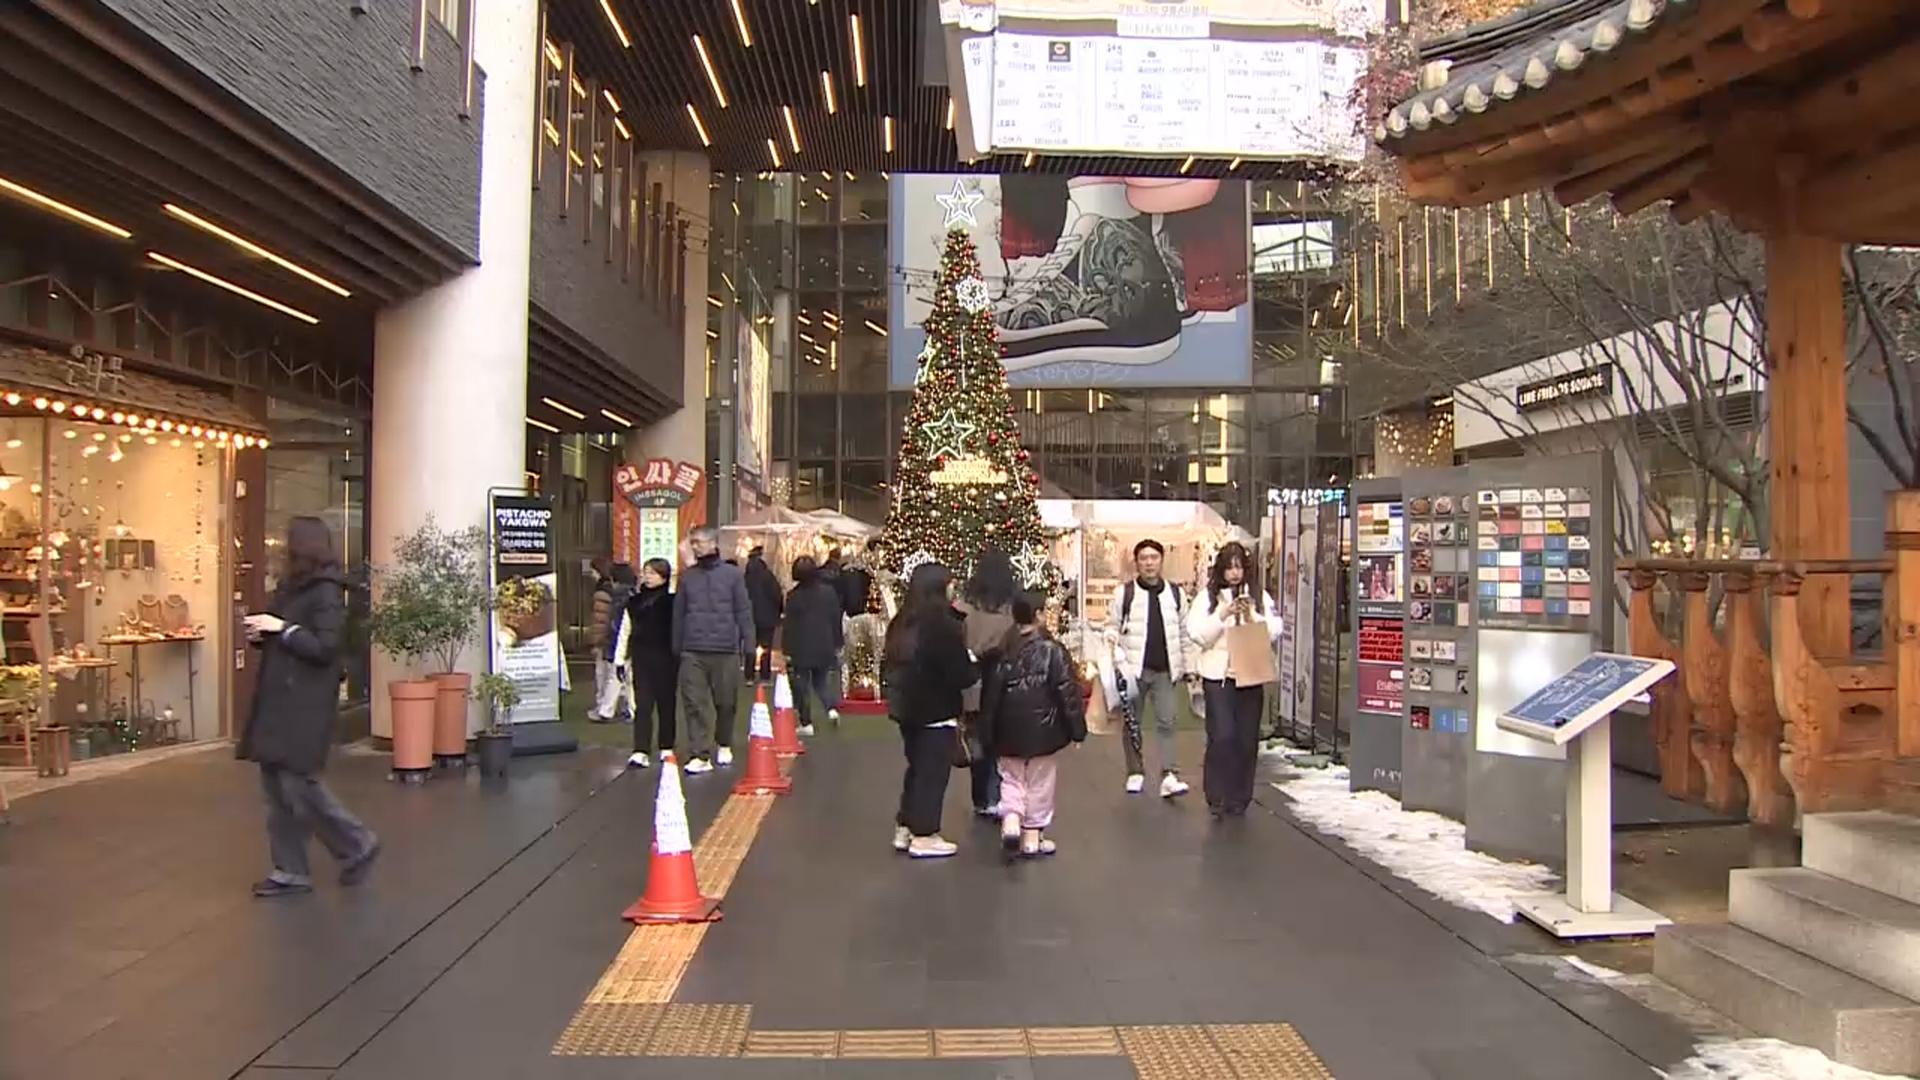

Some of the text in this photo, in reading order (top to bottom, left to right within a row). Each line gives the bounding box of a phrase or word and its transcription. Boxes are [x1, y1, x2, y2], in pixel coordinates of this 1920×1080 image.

[1520, 391, 1536, 405] LINE
[496, 508, 551, 519] PISTACHIO
[500, 518, 547, 527] YAKGWA
